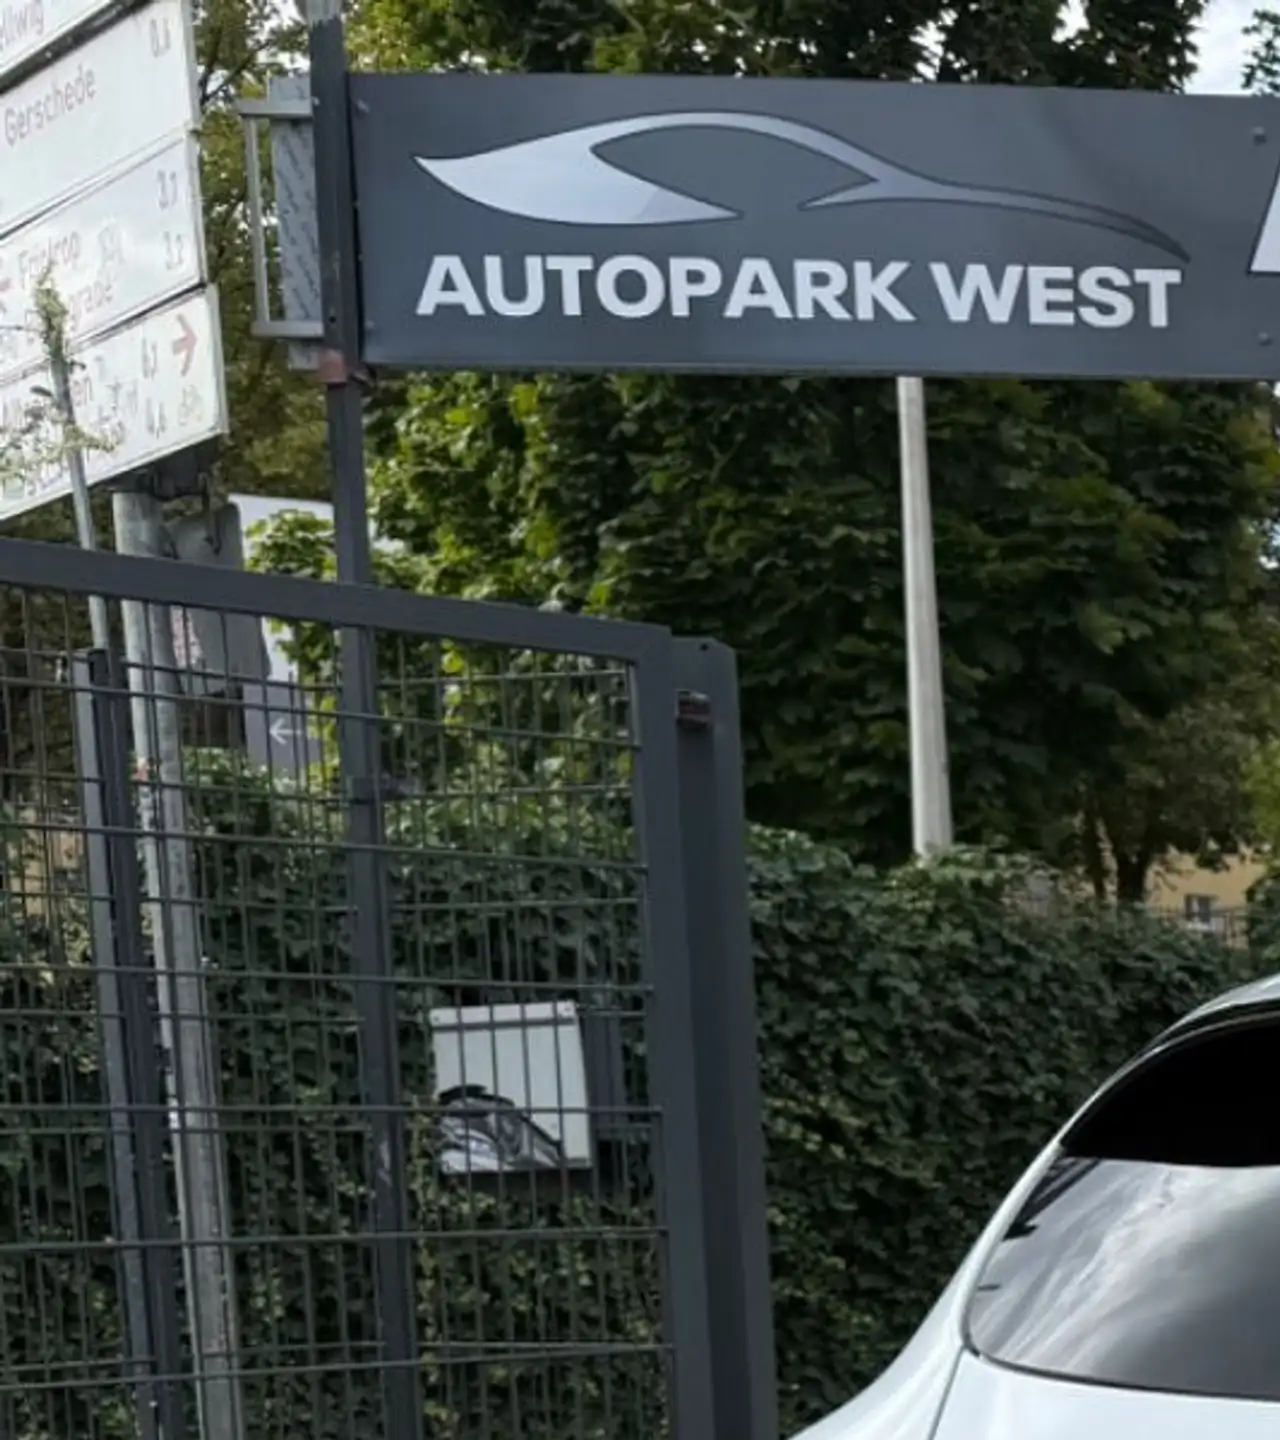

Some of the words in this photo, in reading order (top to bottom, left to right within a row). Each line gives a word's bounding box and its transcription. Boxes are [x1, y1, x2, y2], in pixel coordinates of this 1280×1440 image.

[5, 64, 97, 148] Gerschede
[415, 254, 916, 322] AUTOPARK
[929, 262, 1182, 328] WEST
